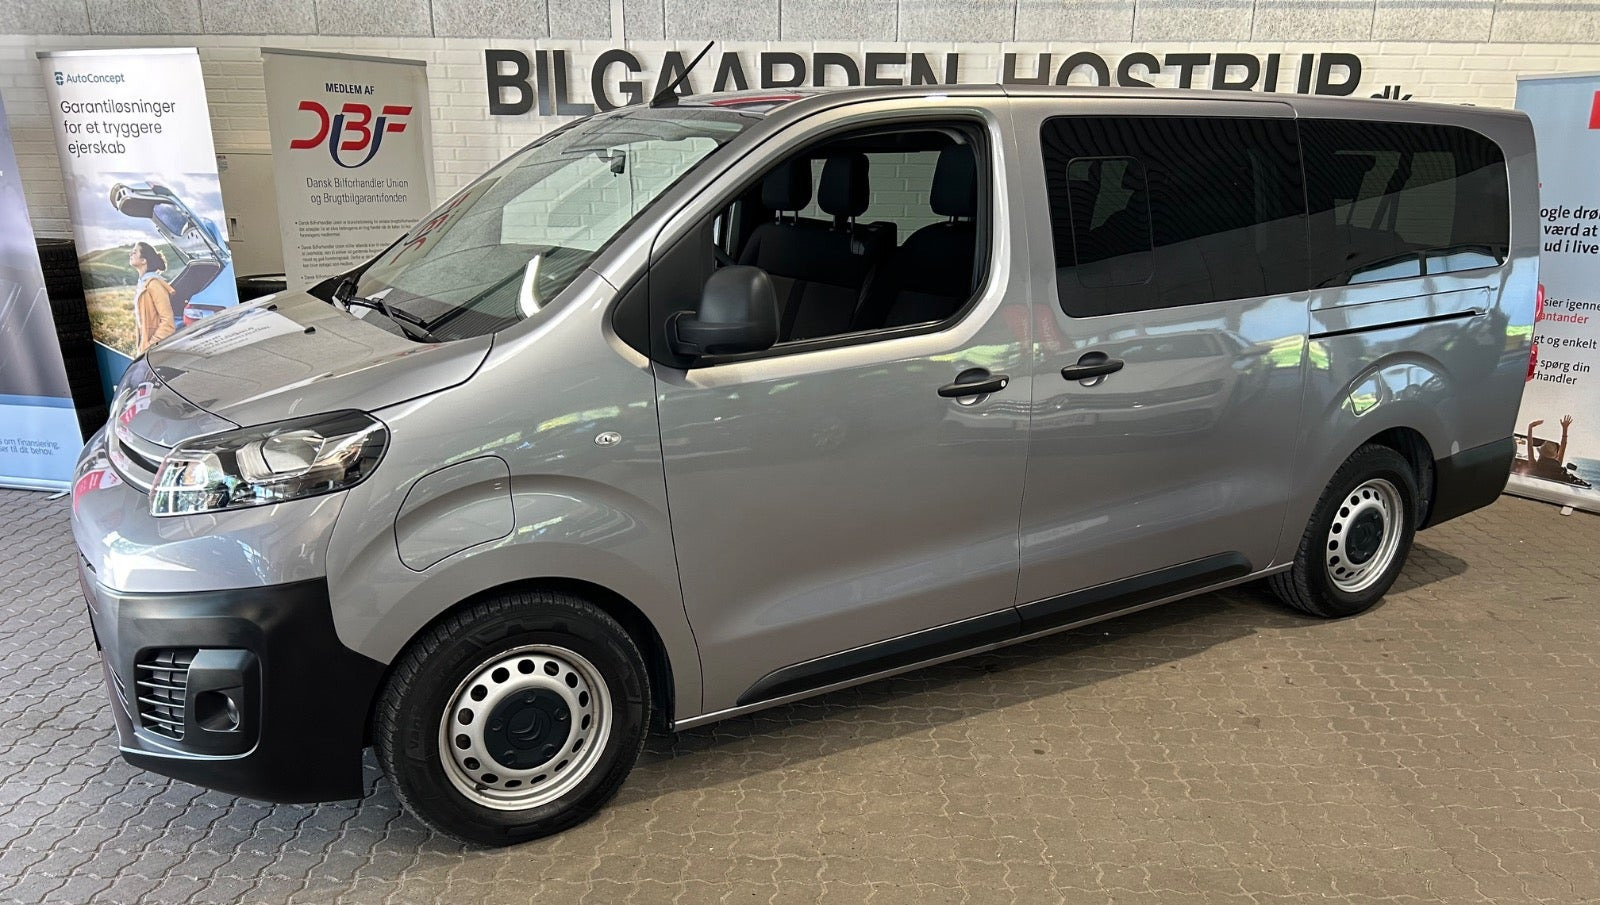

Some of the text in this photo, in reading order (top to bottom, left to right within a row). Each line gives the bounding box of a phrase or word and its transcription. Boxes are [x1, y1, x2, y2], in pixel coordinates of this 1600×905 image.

[66, 73, 125, 84] AutoConcept
[484, 49, 959, 116] BILGAARDEN
[325, 82, 375, 95] MEDLEM AF
[60, 99, 175, 118] Garantiløsninger
[64, 120, 162, 138] for et tryggere
[68, 140, 126, 158] ejerskab
[306, 177, 409, 188] Dansk Bilforhandler Union
[310, 193, 407, 205] og Brugtbilgarantifonden
[1573, 205, 1600, 221] drø
[1544, 222, 1598, 237] værd at
[1544, 239, 1600, 254] ud i live
[1546, 336, 1560, 348] og
[1562, 337, 1597, 350] enkelt
[1540, 359, 1570, 373] spørg
[1572, 361, 1590, 373] din
